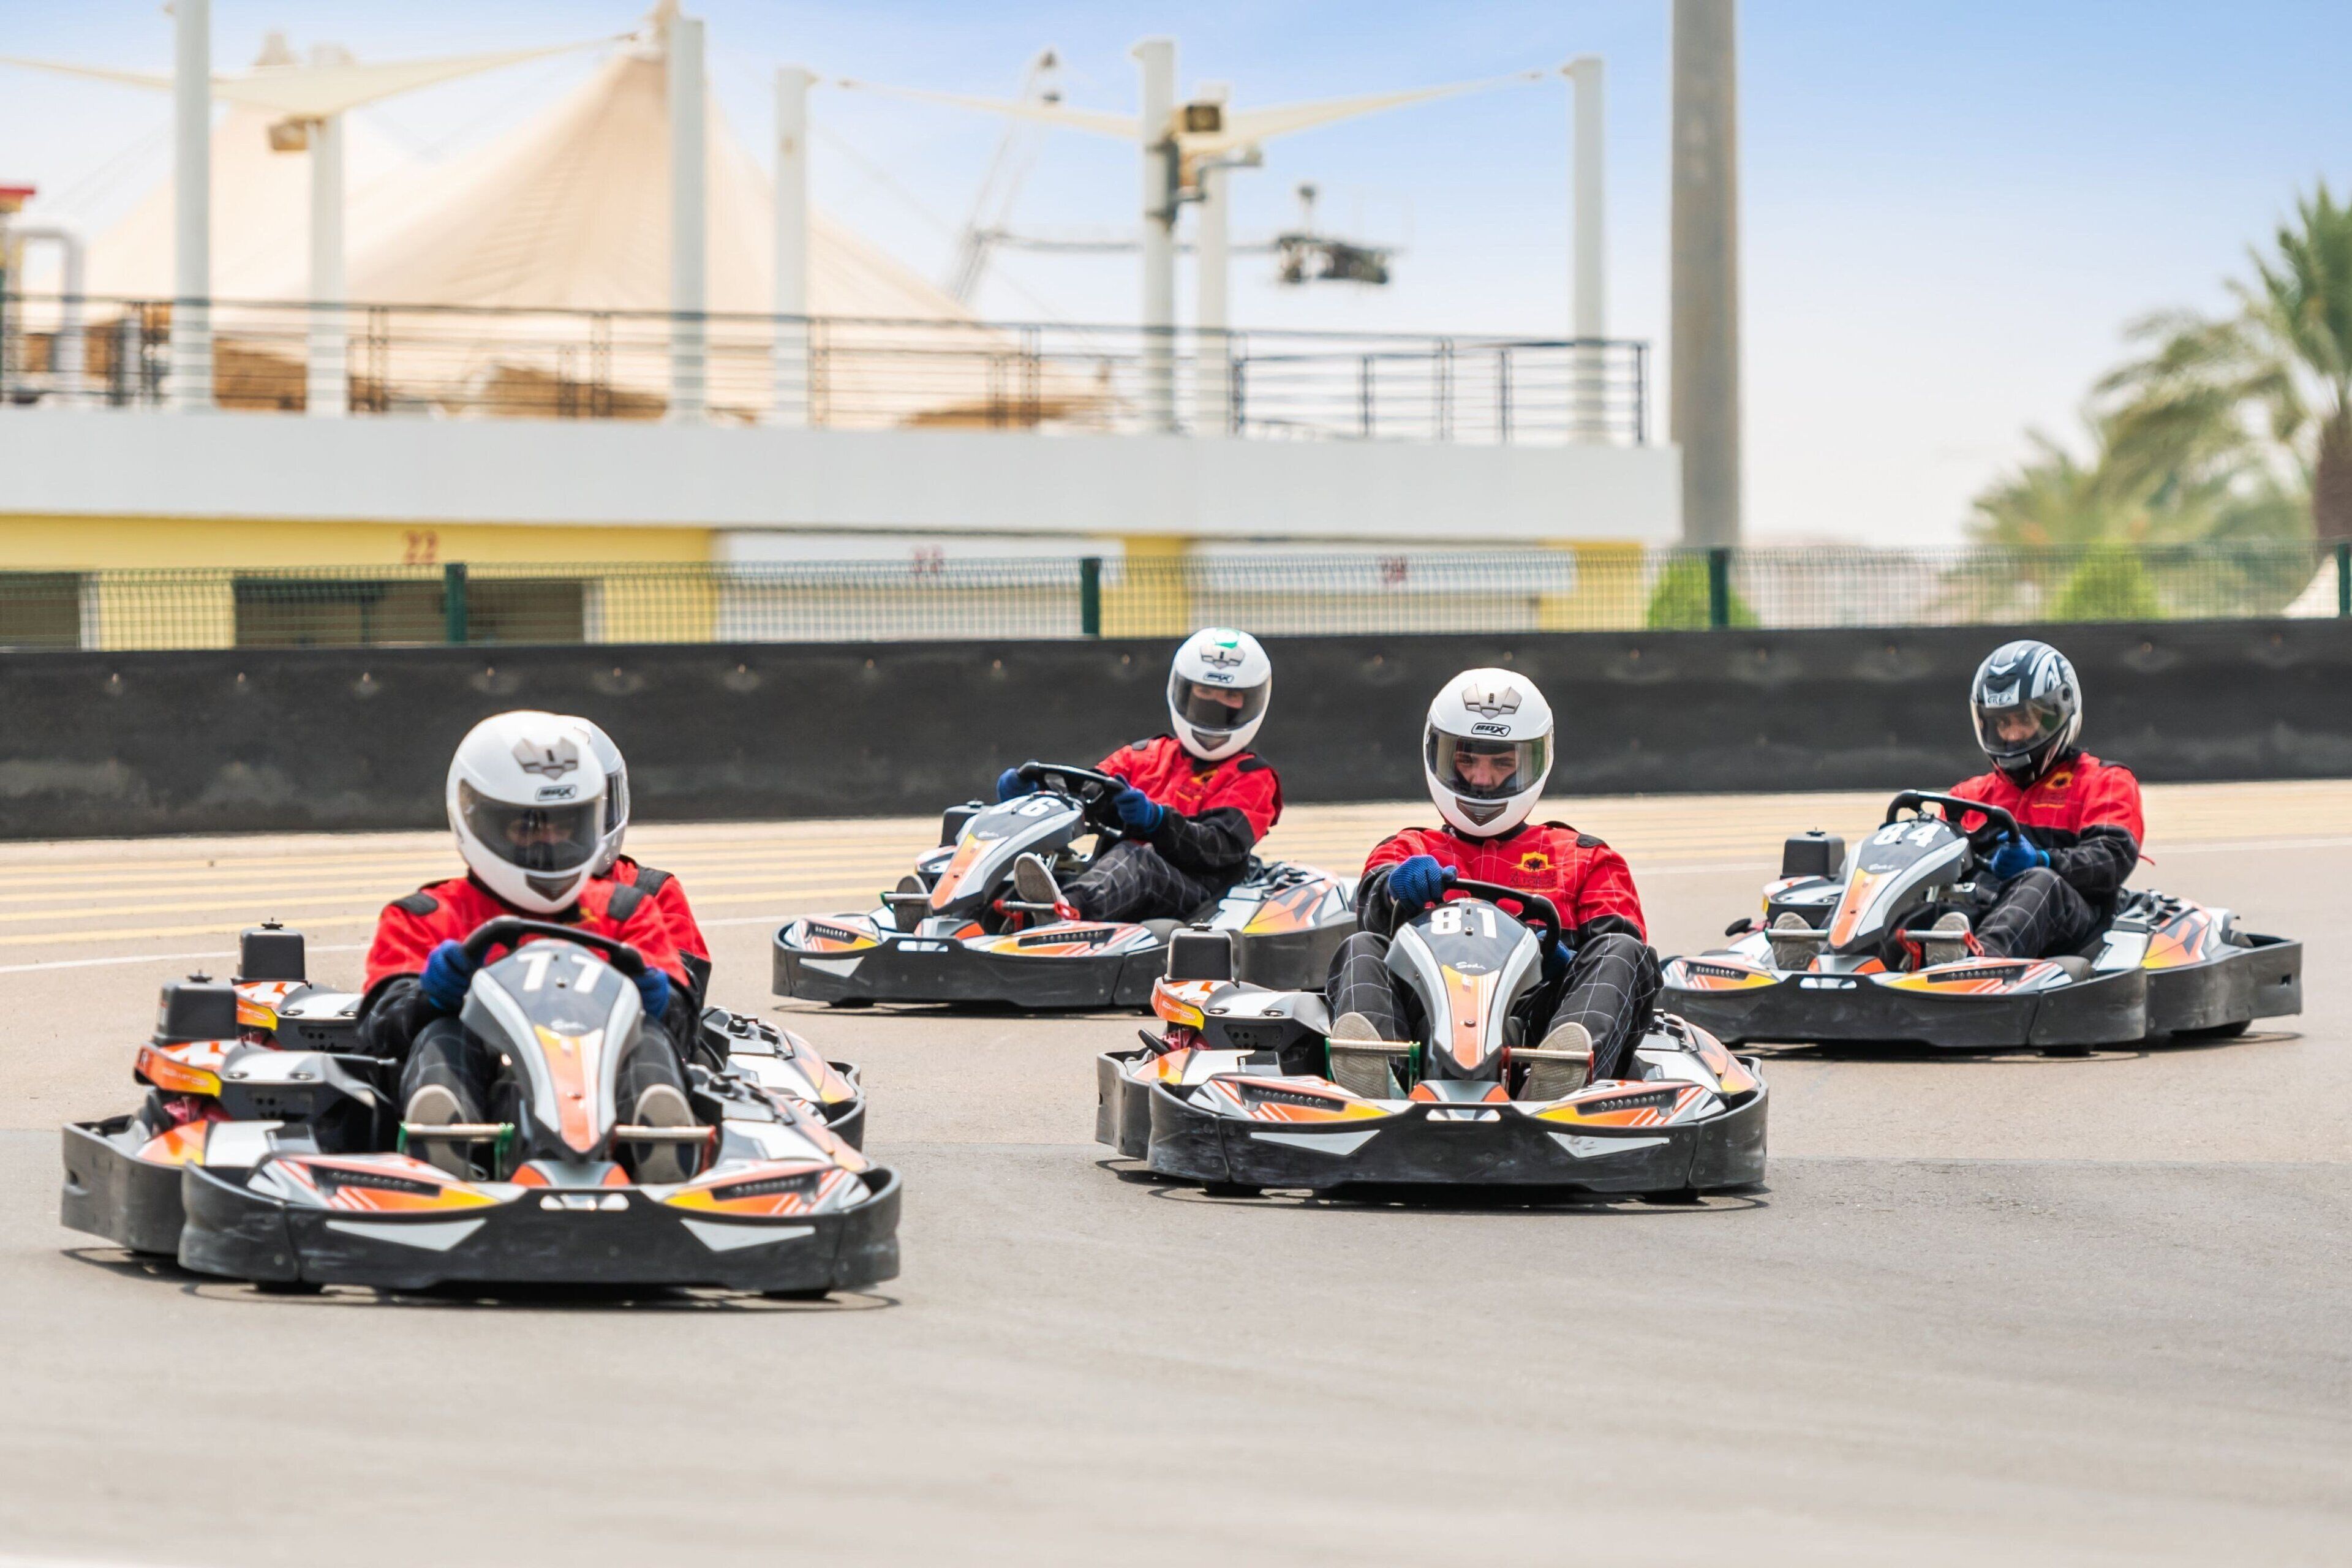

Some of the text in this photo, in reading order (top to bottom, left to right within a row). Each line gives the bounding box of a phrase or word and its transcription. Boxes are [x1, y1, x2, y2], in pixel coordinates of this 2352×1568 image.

[1872, 821, 1942, 848] 84
[1431, 907, 1497, 938] 81
[516, 951, 605, 994] 77
